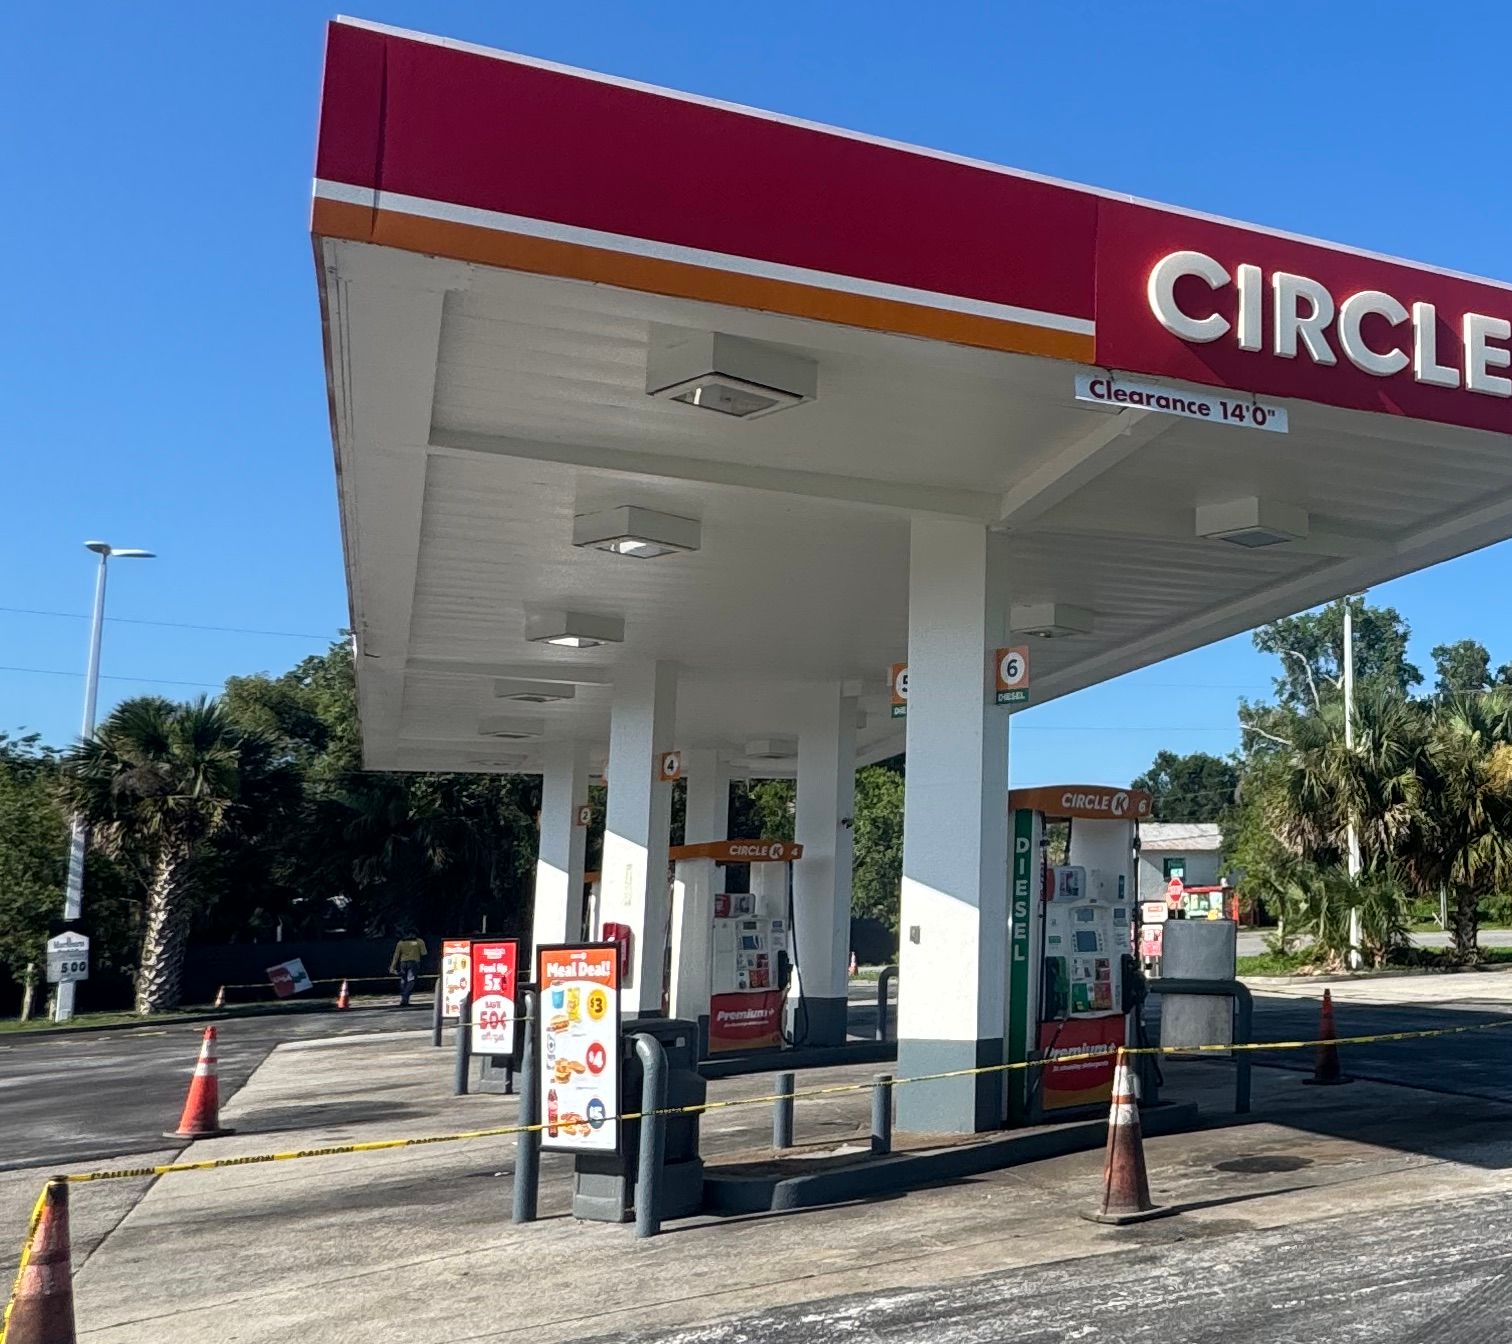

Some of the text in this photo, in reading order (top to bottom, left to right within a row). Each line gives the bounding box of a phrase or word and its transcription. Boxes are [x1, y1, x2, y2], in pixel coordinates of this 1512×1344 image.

[1147, 250, 1512, 398] CIRCLE
[1089, 379, 1211, 417] Clearance
[1006, 658, 1018, 678] 6
[997, 691, 1026, 702] DIESEL
[667, 759, 674, 771] 4
[1062, 792, 1147, 816] CIRCLE K 6
[583, 811, 589, 820] 2
[729, 843, 798, 859] CIRCLE K 4
[1014, 837, 1030, 961] DIESEL
[546, 960, 611, 978] Meal Deal!
[590, 997, 603, 1013] $3
[589, 1051, 603, 1068] $4
